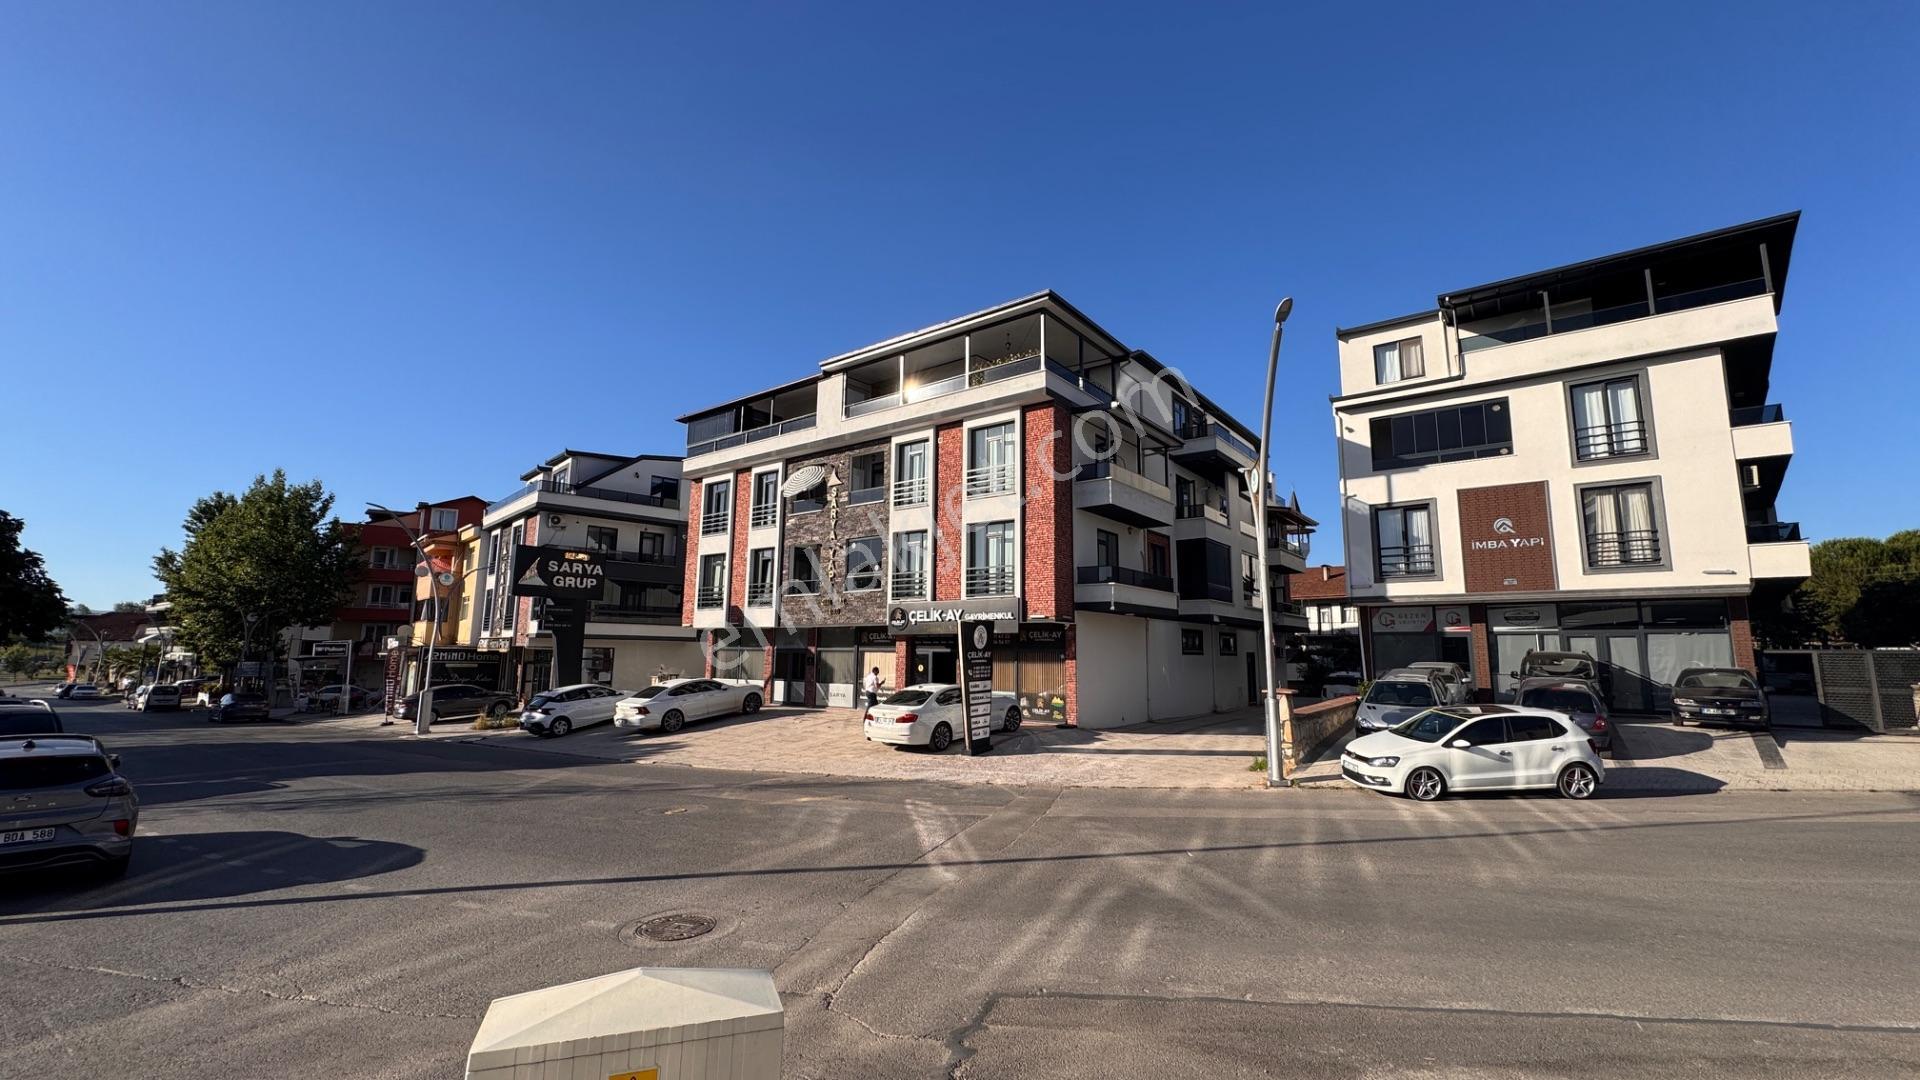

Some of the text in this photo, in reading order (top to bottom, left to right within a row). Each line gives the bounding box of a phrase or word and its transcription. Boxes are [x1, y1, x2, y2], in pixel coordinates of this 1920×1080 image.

[547, 560, 604, 576] SARYA
[552, 575, 597, 589] GRUP
[908, 607, 963, 625] ÇELİK-AY
[964, 611, 1014, 621] GAYRİMENKUL
[32, 828, 54, 840] 588
